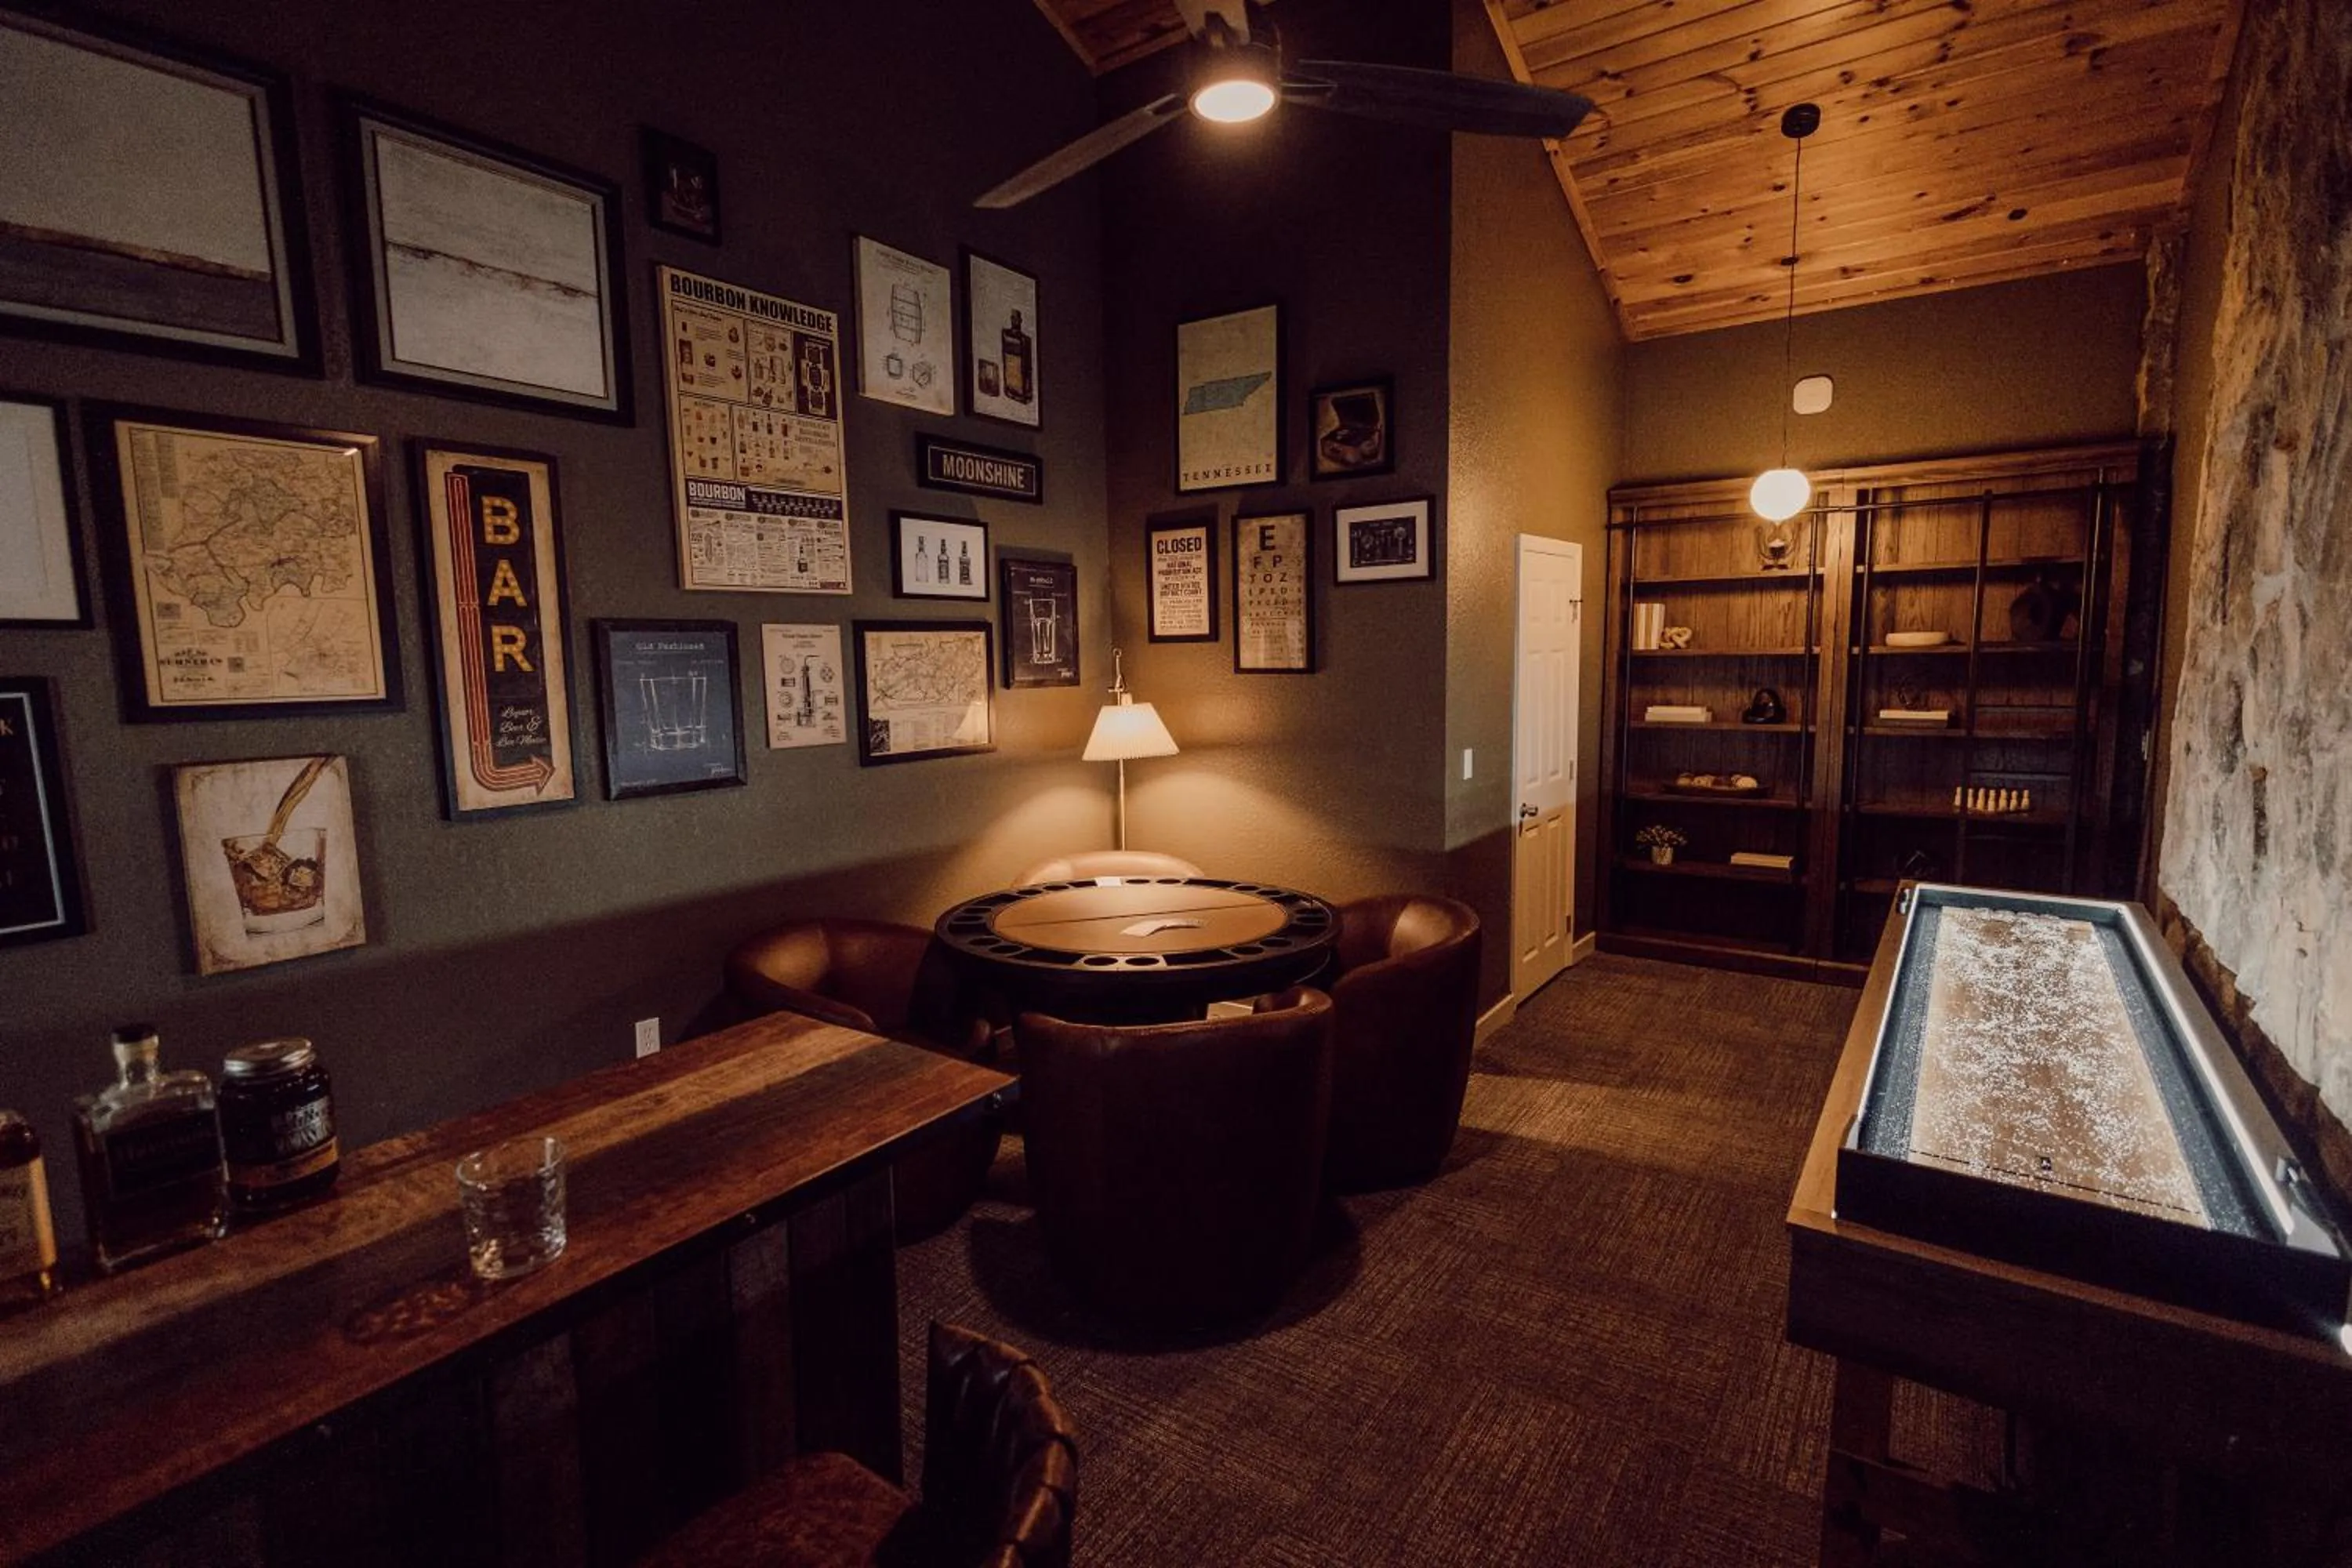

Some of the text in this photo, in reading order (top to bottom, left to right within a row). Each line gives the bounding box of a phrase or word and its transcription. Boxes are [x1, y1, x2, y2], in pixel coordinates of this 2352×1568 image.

[670, 274, 746, 311] BOURBON
[749, 296, 833, 333] KNOWLEDGE
[942, 454, 1025, 489] MOONSHINE
[1183, 463, 1272, 482] TENNESSEE
[688, 482, 746, 503] BOURBON
[1156, 537, 1202, 554] CLOSED
[1259, 524, 1276, 550] E
[480, 495, 535, 673] BAR
